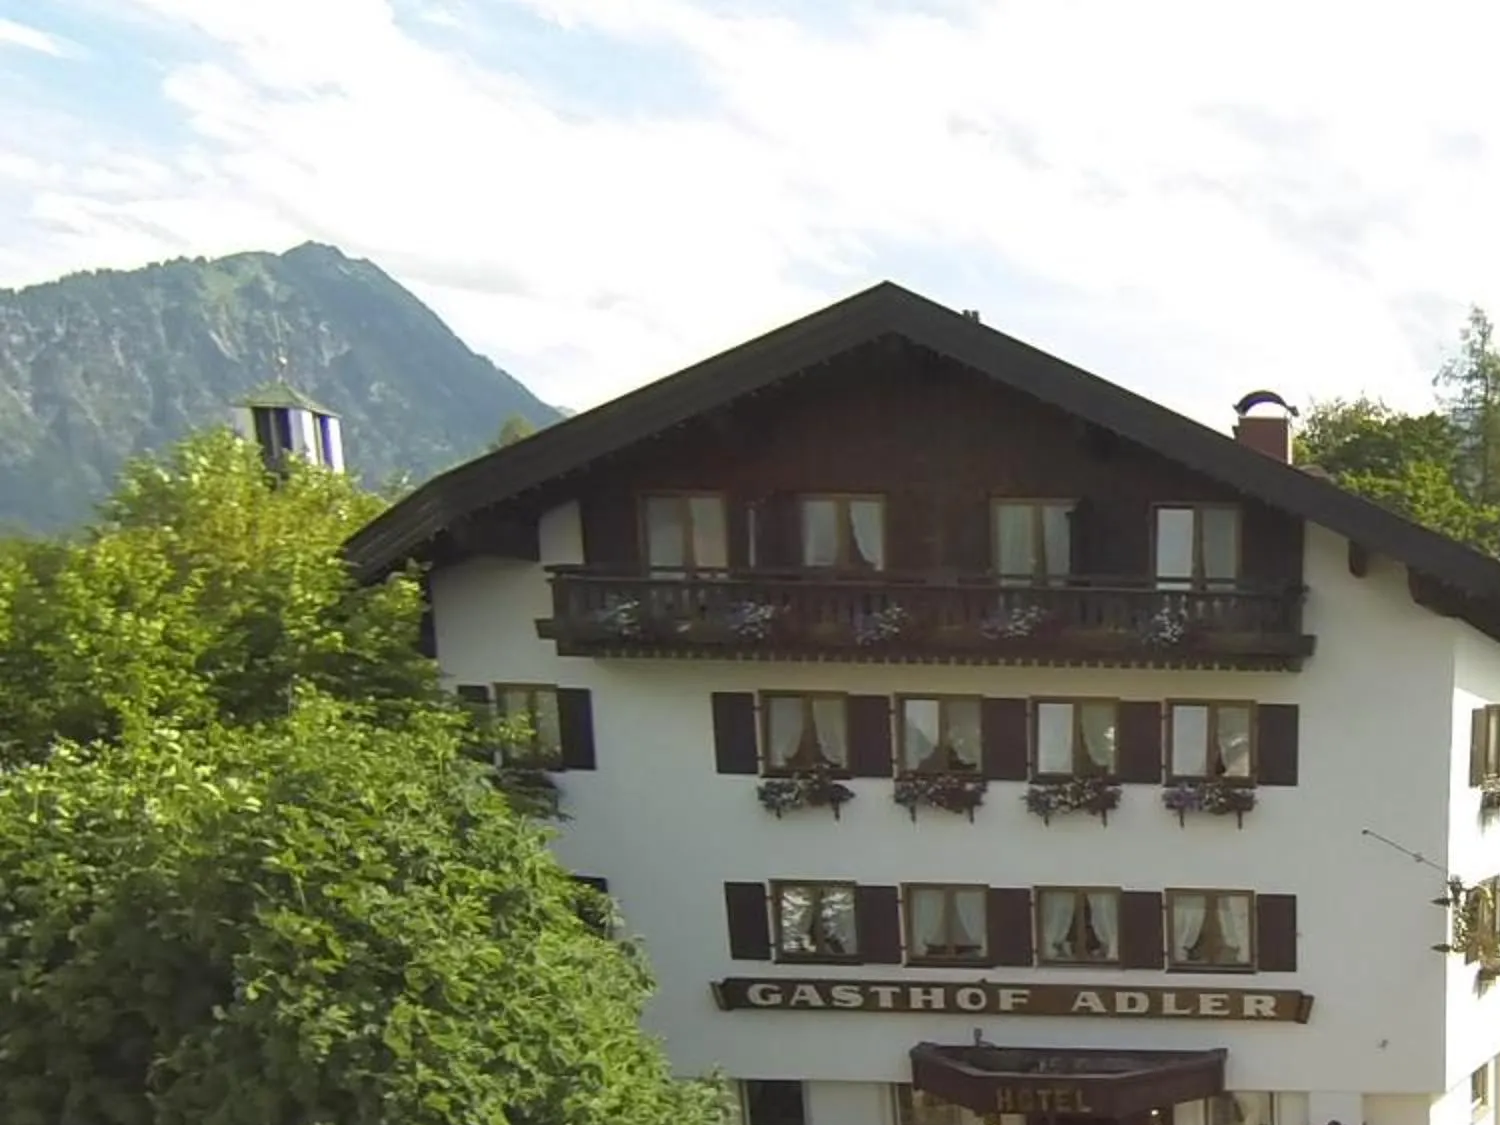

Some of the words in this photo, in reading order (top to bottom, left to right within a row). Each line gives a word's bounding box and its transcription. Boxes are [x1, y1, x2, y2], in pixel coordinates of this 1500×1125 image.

[747, 983, 1030, 1011] GASTHOF
[1071, 991, 1277, 1017] ADLER
[996, 1088, 1092, 1113] HOTEL
